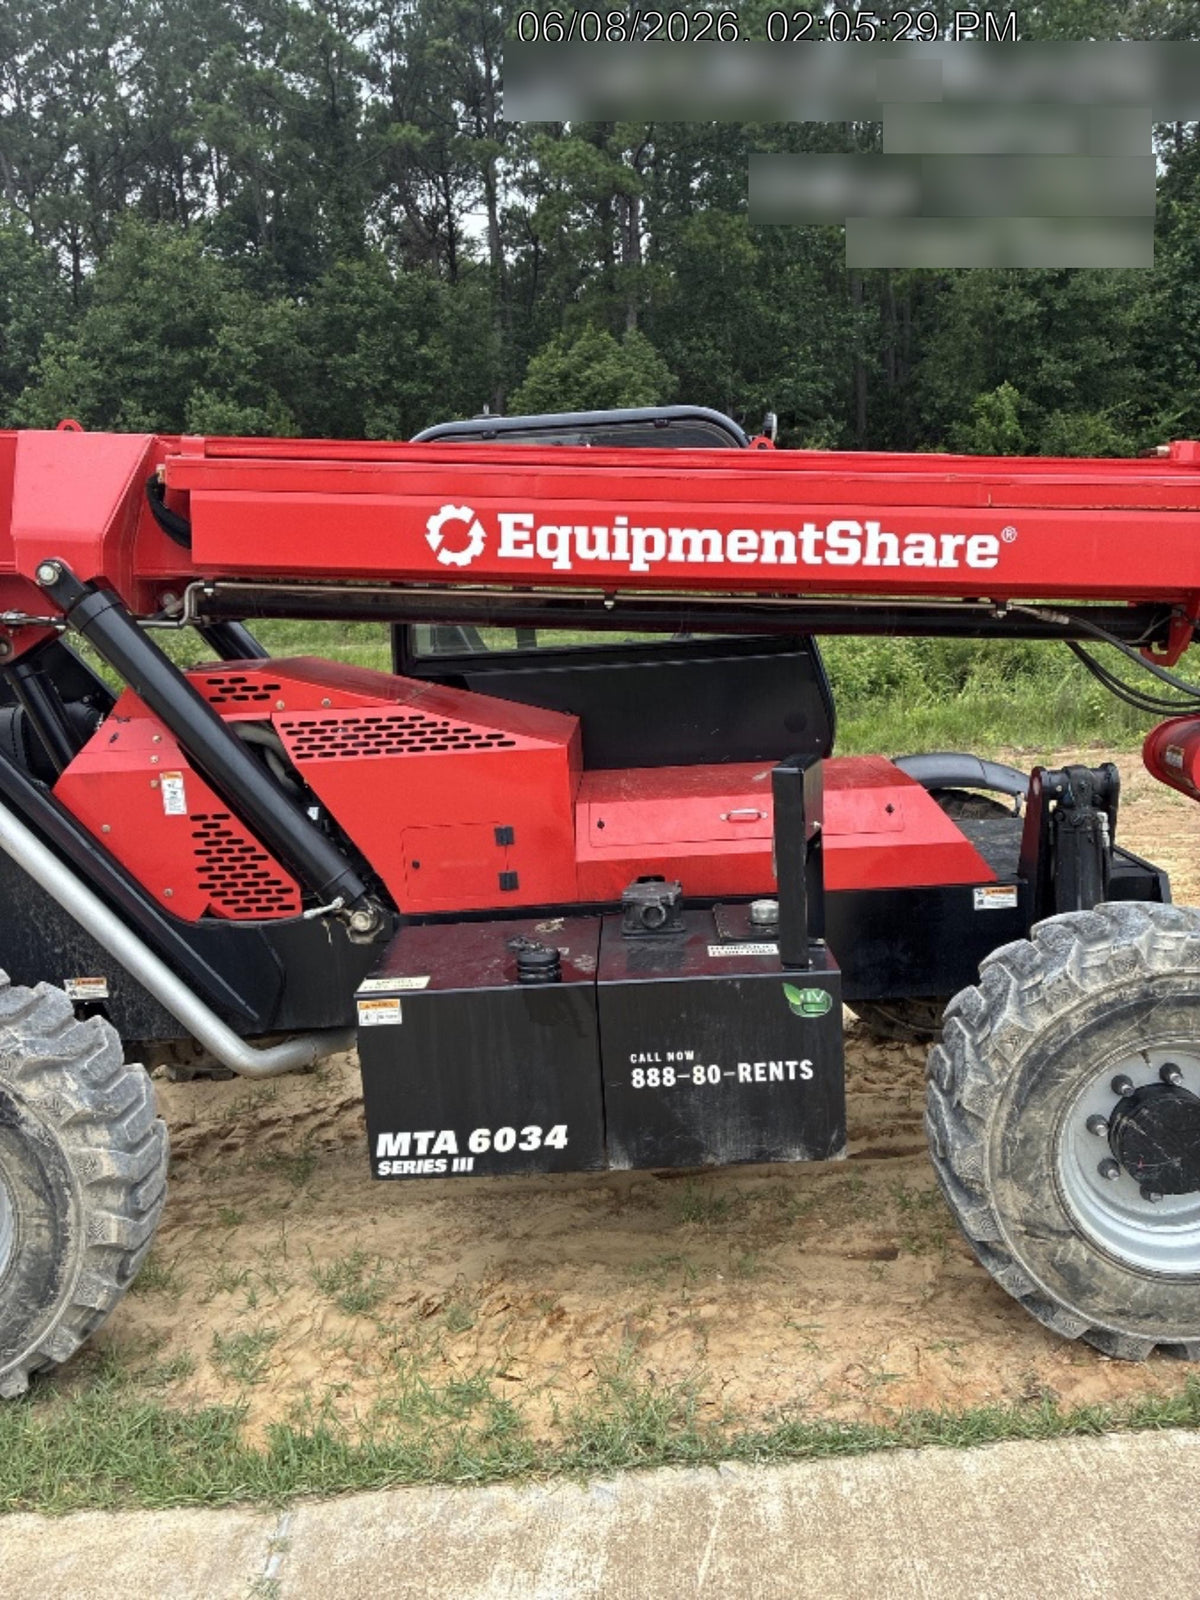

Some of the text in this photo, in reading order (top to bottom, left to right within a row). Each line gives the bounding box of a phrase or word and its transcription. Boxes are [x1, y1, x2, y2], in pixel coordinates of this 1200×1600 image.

[630, 1050, 696, 1064] CALL NOW
[630, 1059, 815, 1090] 888-80-RENTS
[376, 1124, 569, 1158] MTA 6034
[377, 1156, 475, 1176] SERIES III
